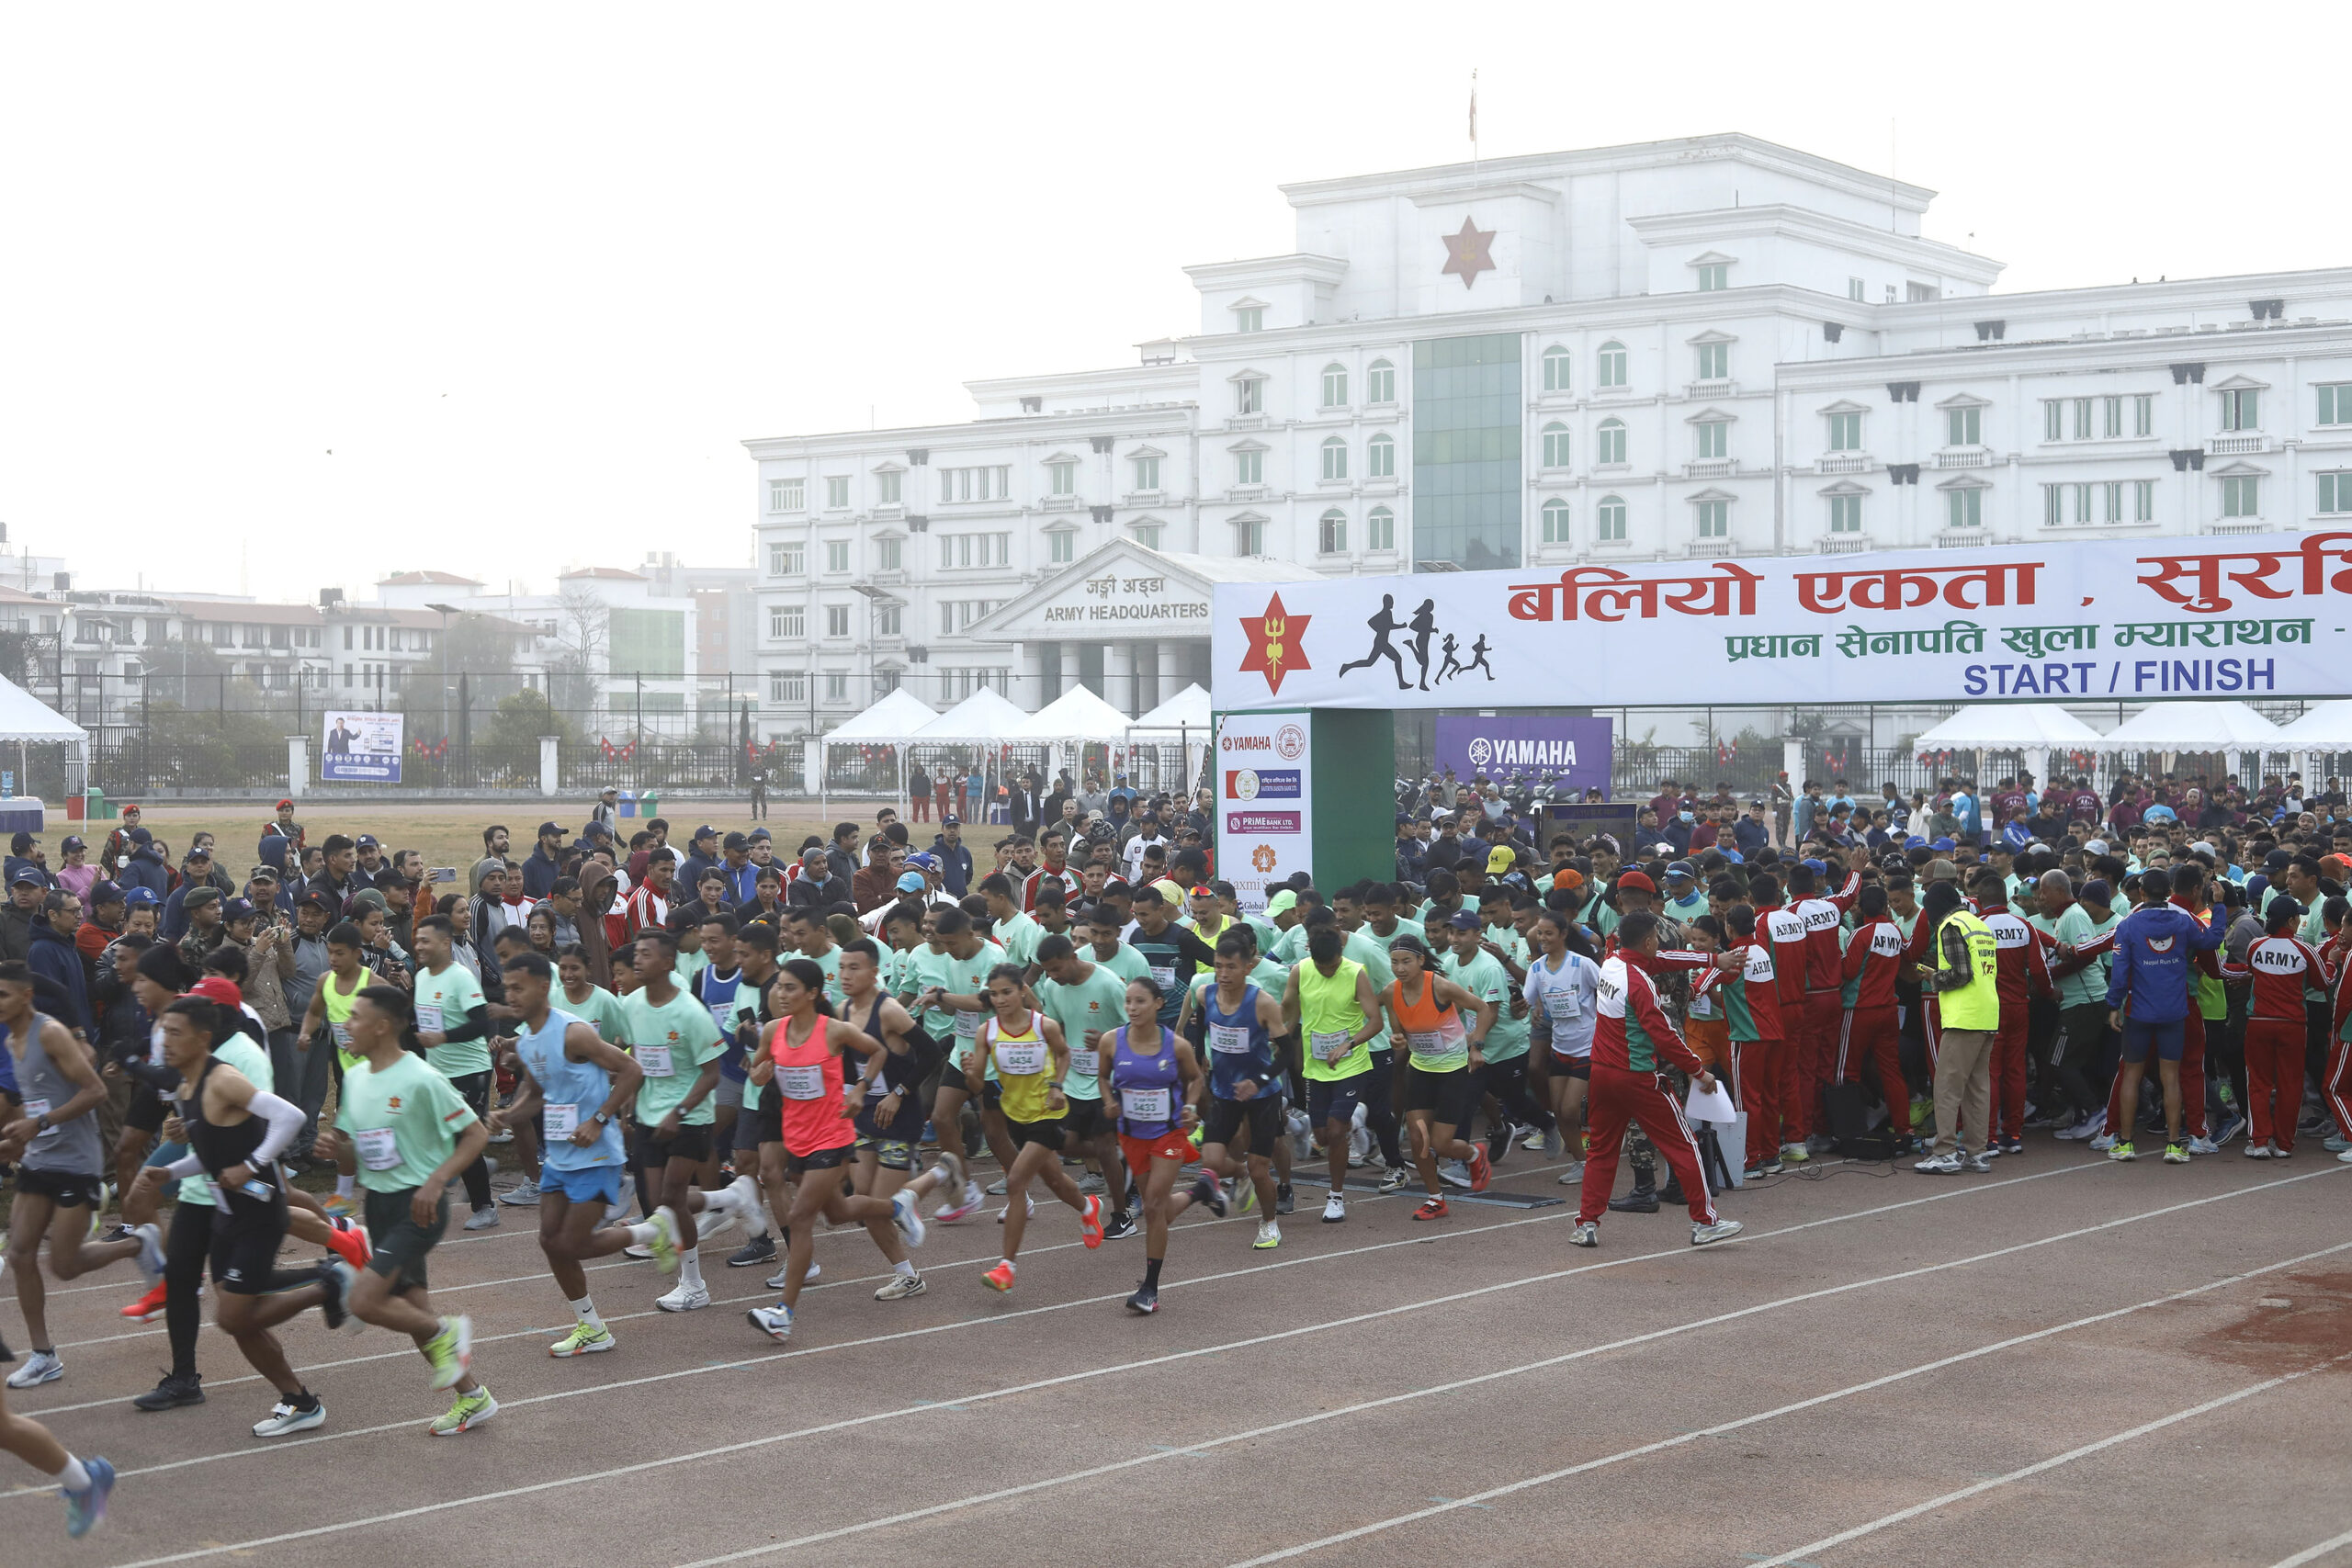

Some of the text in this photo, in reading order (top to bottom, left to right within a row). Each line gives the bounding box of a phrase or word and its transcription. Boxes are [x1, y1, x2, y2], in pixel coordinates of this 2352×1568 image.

[1508, 562, 1765, 622] बलियो
[1792, 562, 2045, 614] एकता
[1045, 603, 1209, 622] ARMY HEADQUARTERS
[1724, 634, 1824, 662] प्रधान
[1836, 620, 1987, 659] सेनापति
[2000, 625, 2101, 659] खुला
[2114, 618, 2315, 648] म्याराथन
[1963, 662, 2097, 695] START
[2134, 658, 2275, 693] FINISH
[1234, 736, 1271, 750] YAMAHA
[1493, 739, 1577, 765] YAMAHA
[1244, 901, 1264, 909] Global
[1804, 910, 1837, 928] ARMY
[1776, 923, 1803, 937] ARMY
[1995, 929, 2024, 940] RMY
[1873, 936, 1901, 950] ARMY
[2254, 951, 2301, 968] ARMY
[1752, 964, 1770, 975] ARM
[1009, 1056, 1032, 1065] 0434
[1133, 1103, 1156, 1111] 0433
